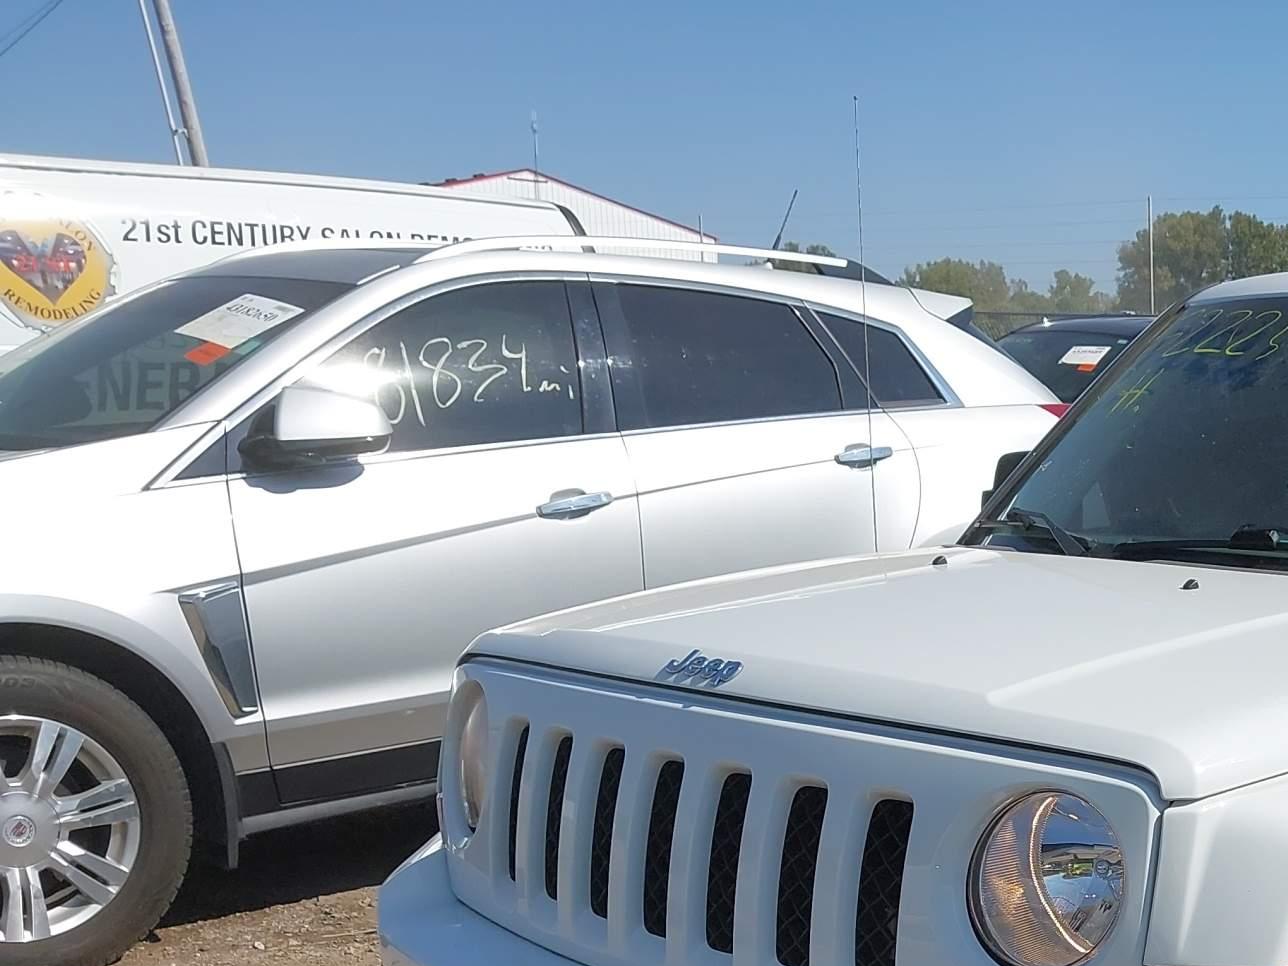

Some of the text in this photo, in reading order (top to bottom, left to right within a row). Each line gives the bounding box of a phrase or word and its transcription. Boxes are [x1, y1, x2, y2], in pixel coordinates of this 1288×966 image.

[121, 218, 183, 244] 21st
[4, 288, 101, 320] REMODELING
[665, 648, 745, 688] Jeep
